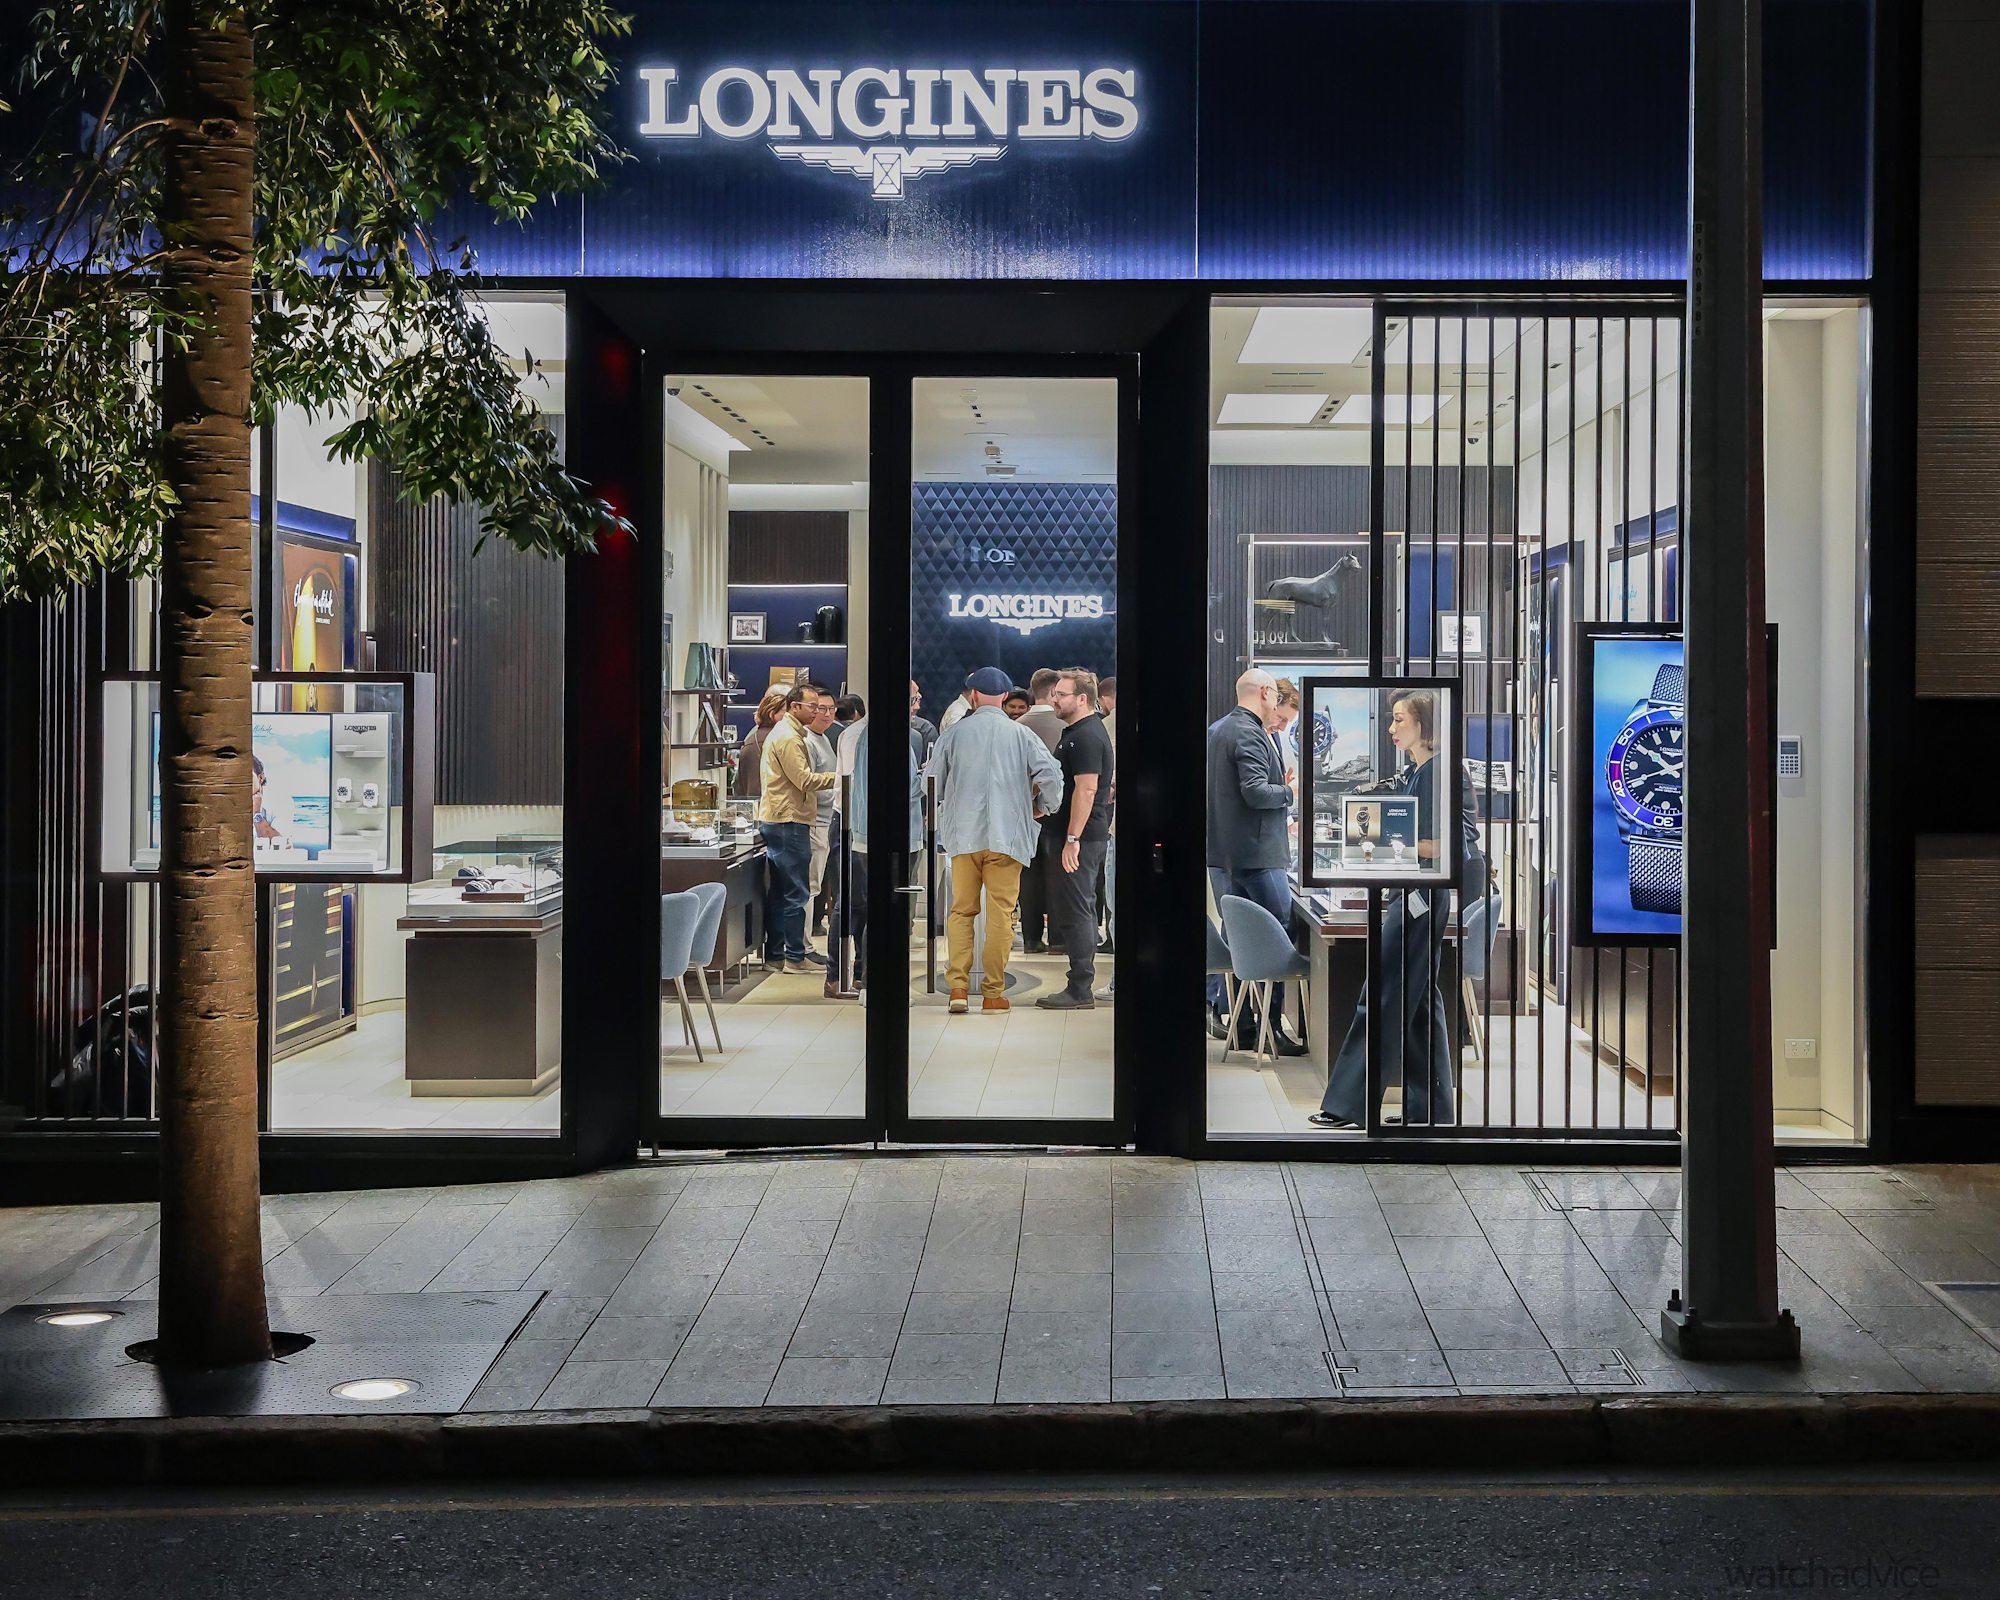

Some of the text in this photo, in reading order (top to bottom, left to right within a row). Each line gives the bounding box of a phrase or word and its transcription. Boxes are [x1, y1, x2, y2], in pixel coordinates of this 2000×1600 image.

[639, 67, 1139, 140] LONGINES
[949, 594, 1104, 618] LONGINES
[1616, 727, 1635, 747] 50
[1611, 779, 1626, 798] 40
[1653, 815, 1675, 828] 30
